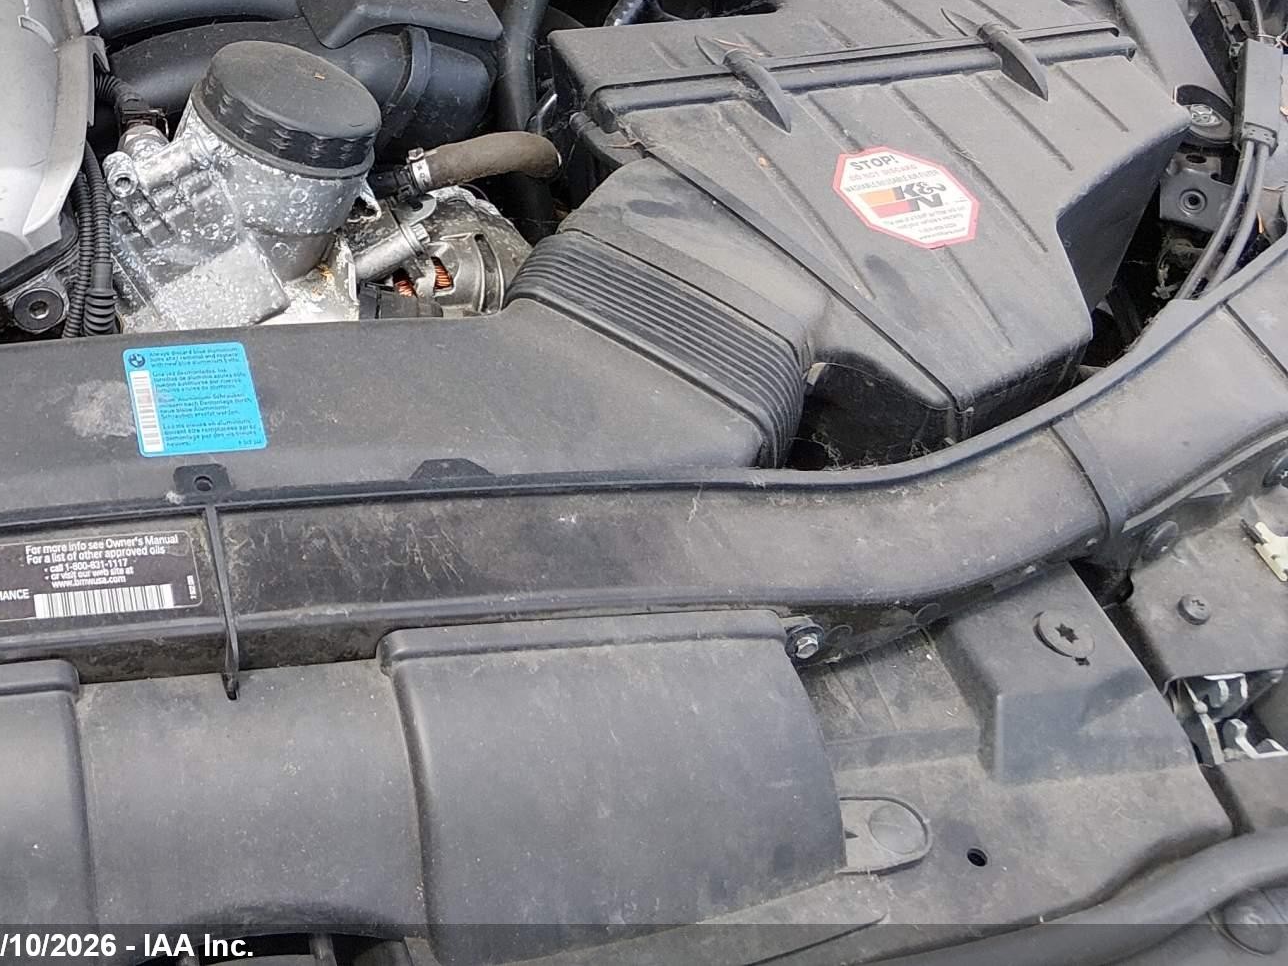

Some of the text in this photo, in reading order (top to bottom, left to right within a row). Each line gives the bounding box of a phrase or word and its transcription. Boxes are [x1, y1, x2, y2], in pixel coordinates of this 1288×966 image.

[849, 154, 899, 171] STOP!
[25, 534, 179, 555] For more info see Owner's Manual
[26, 545, 165, 565] For a list of other approved oils
